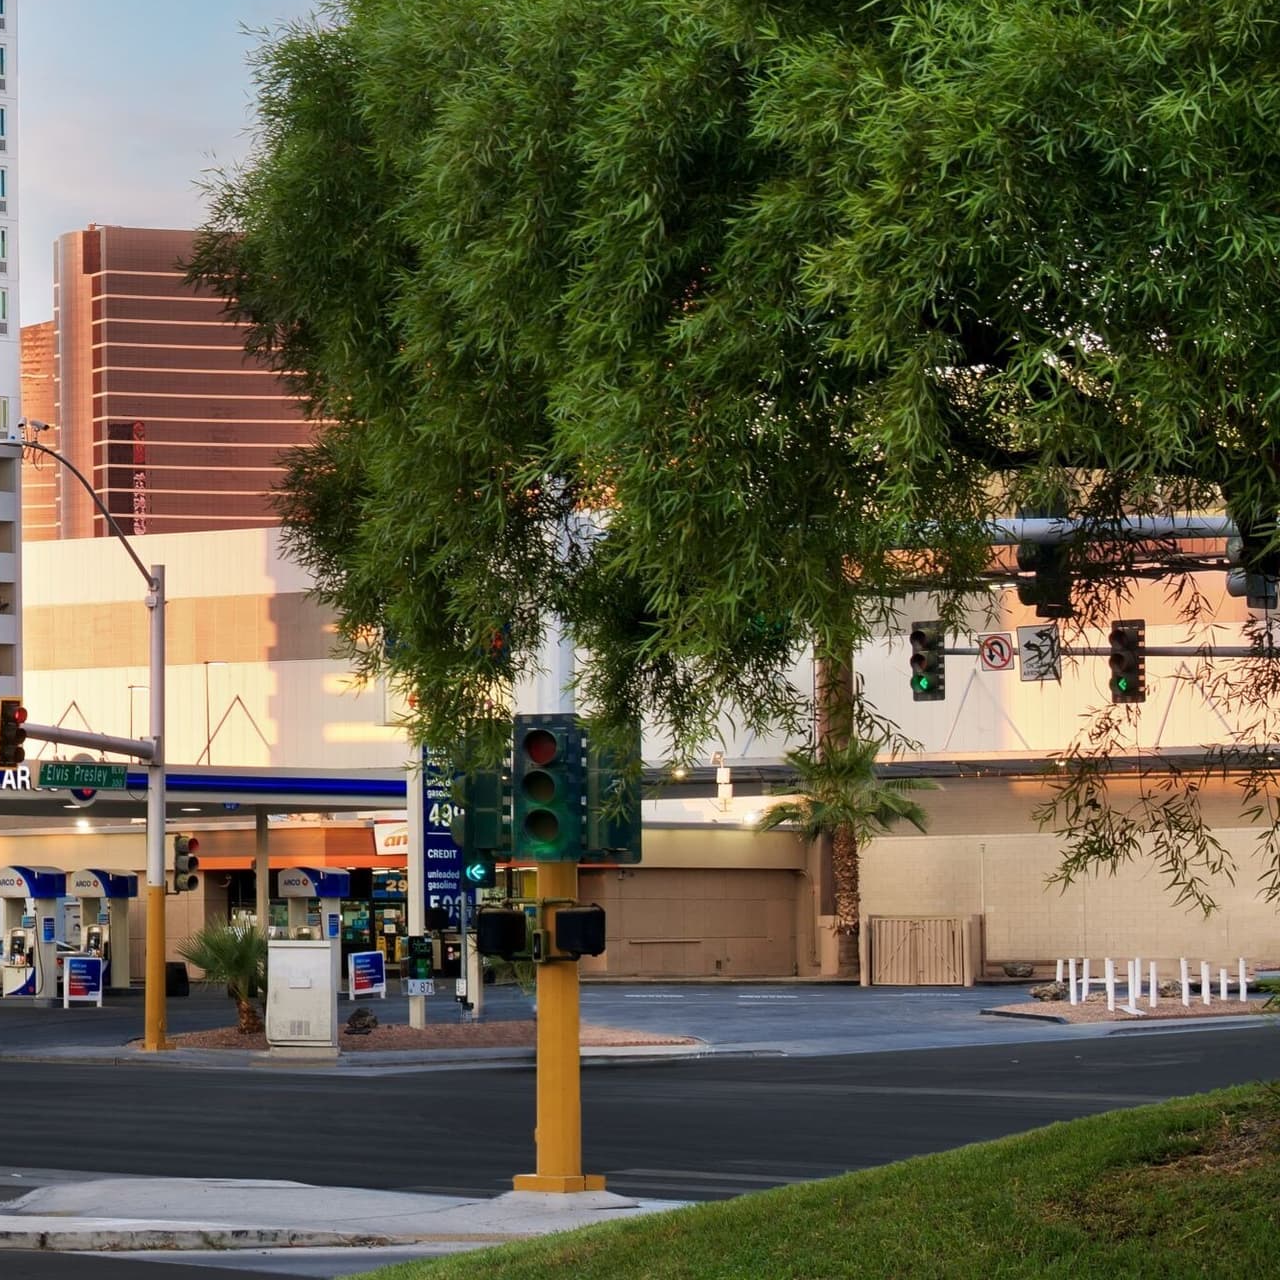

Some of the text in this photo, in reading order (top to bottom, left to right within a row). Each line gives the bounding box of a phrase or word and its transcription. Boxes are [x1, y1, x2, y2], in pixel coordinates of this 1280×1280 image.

[46, 764, 69, 781] Elvis
[74, 765, 107, 786] Presley
[427, 849, 458, 859] CREDIT
[427, 869, 460, 879] unleaded
[427, 880, 457, 891] gasoline
